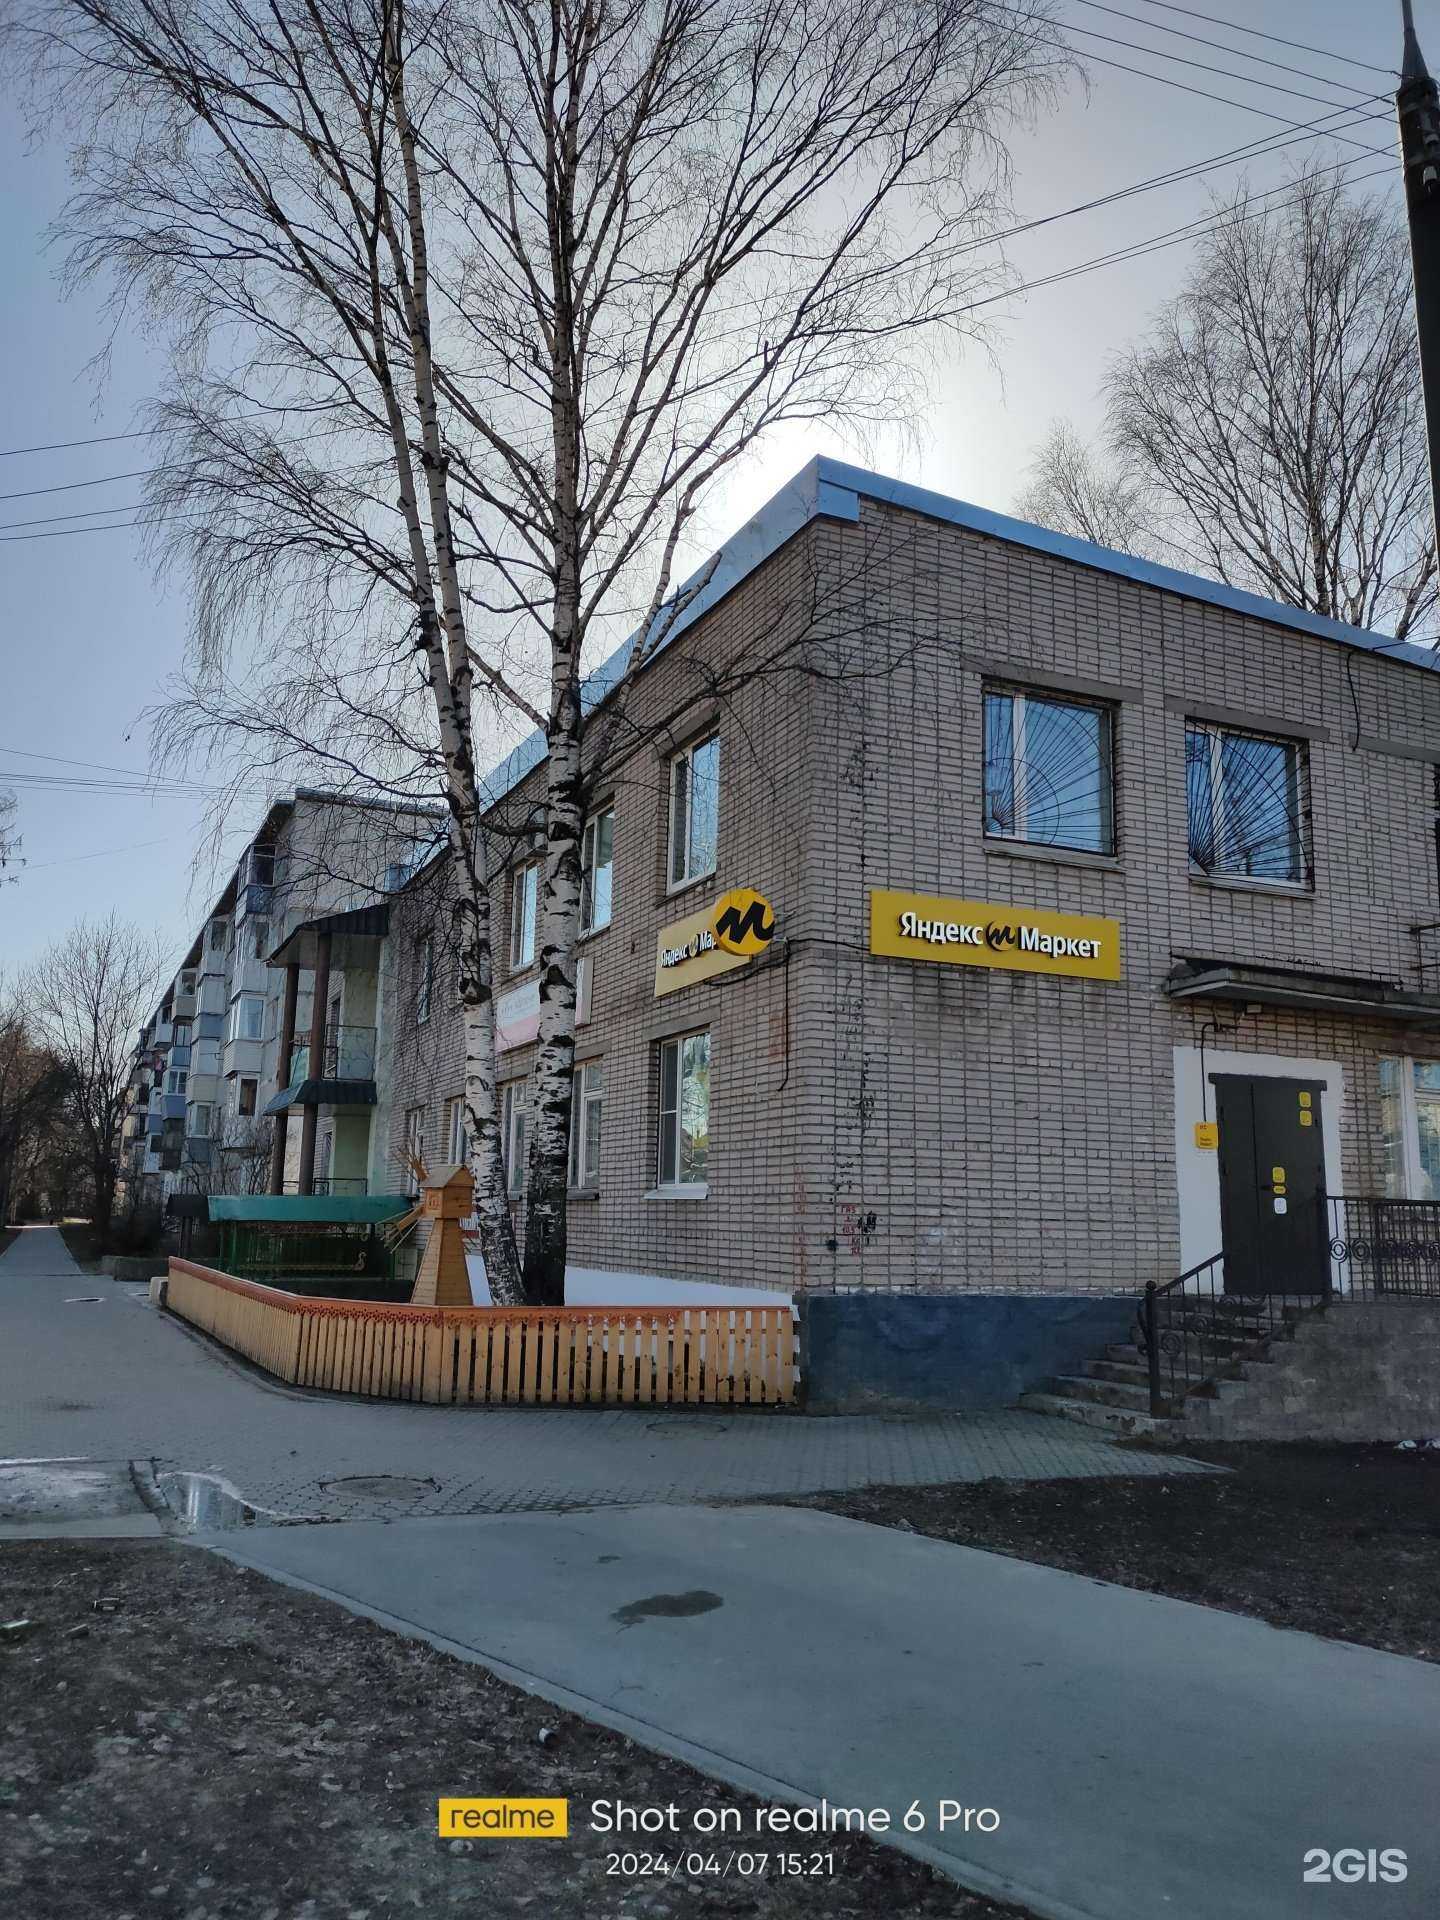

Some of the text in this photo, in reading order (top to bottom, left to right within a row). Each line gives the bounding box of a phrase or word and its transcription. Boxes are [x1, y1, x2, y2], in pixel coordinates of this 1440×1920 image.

[900, 911, 984, 945] Яндекс
[1020, 925, 1102, 958] Маркет
[660, 944, 688, 967] Яндекс
